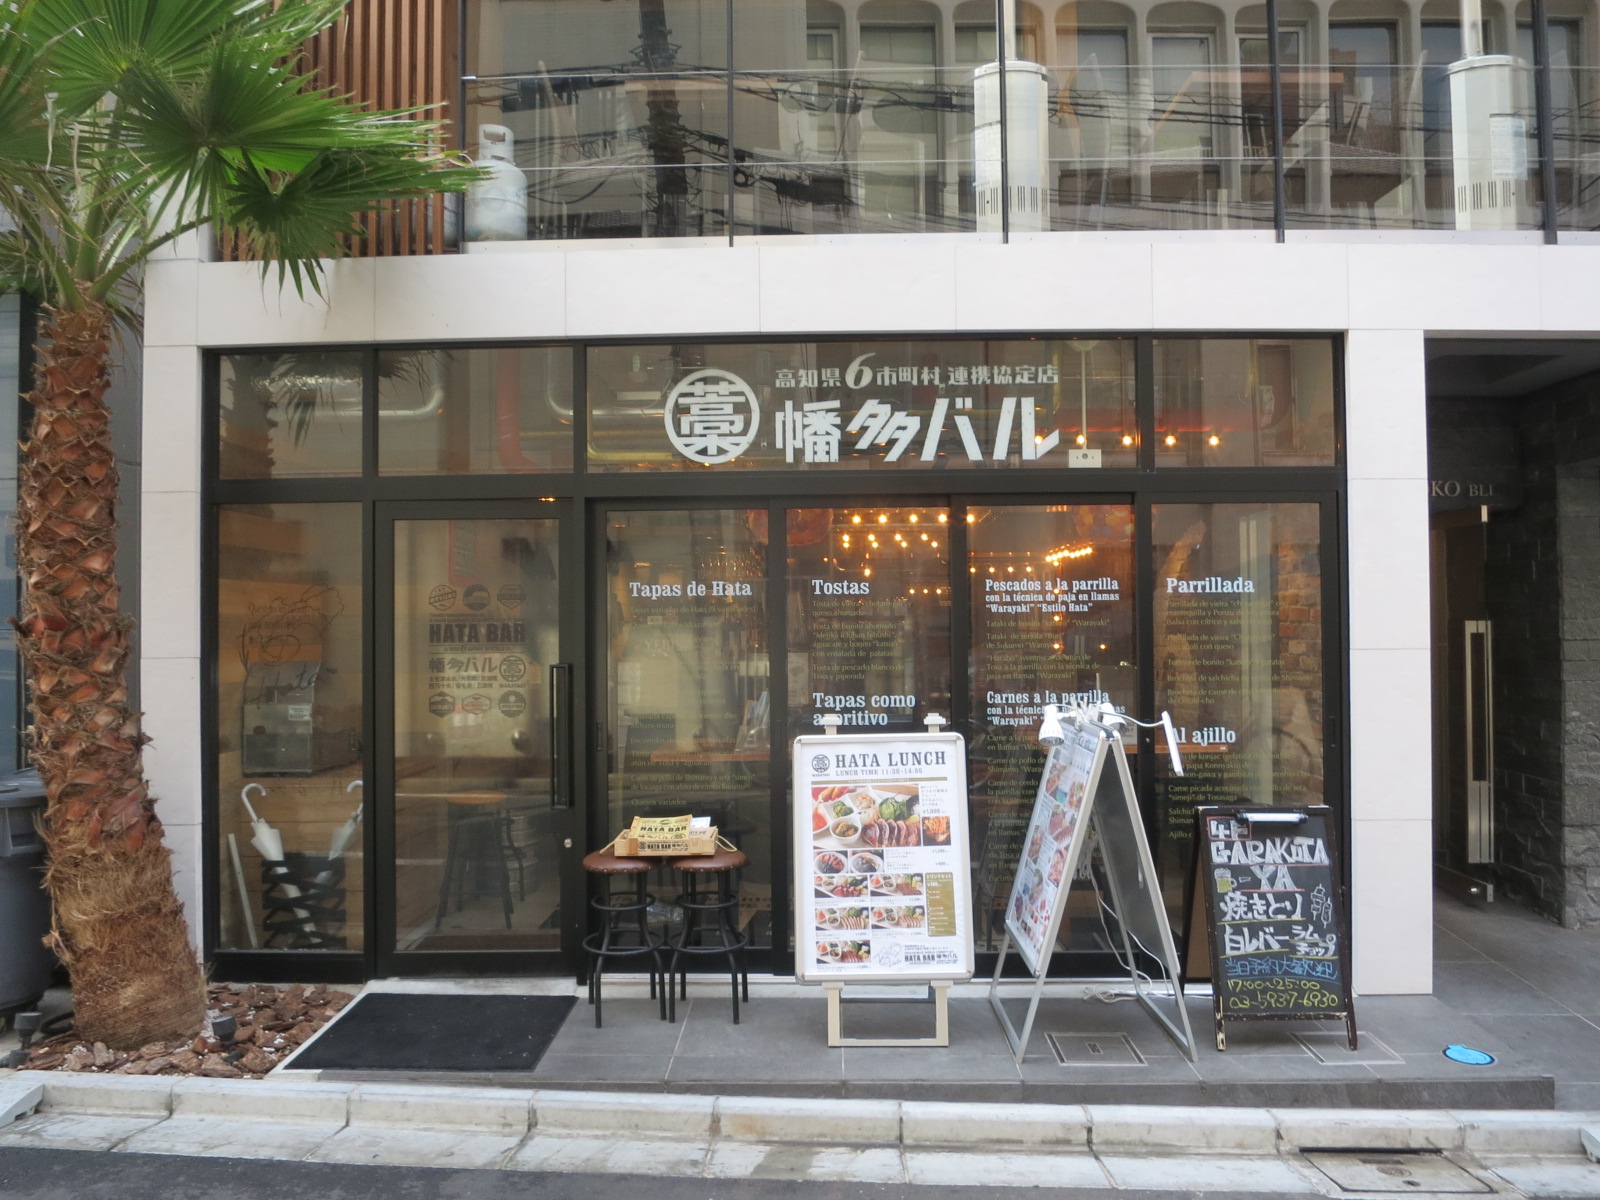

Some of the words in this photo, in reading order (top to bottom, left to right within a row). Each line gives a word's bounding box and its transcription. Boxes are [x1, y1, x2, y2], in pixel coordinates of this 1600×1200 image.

[775, 397, 1059, 463] 幡多バル
[629, 582, 681, 600] Tapas
[687, 581, 706, 596] de
[711, 581, 752, 596] Hata
[812, 579, 869, 595] Tostas
[985, 578, 1041, 591] Pescados
[1045, 581, 1052, 590] a
[1056, 577, 1068, 590] la
[1072, 577, 1119, 592] parrilla
[1166, 577, 1255, 593] Parrillada
[985, 594, 1000, 602] con
[1002, 593, 1011, 602] la
[1013, 592, 1043, 602] técnica
[1045, 593, 1055, 601] de
[1057, 593, 1076, 603] paja
[1090, 592, 1120, 601] llamas
[985, 603, 1035, 614] “Warayaki”
[429, 623, 480, 643] HATA
[486, 623, 525, 643] BAR
[813, 692, 866, 711] Tapas
[871, 695, 916, 708] como
[986, 690, 1029, 704] Carnes
[1033, 693, 1041, 703] a
[1045, 690, 1057, 702] la
[1062, 690, 1110, 705] parrilla
[813, 710, 888, 726] aritivo
[987, 707, 1001, 715] con
[1005, 705, 1013, 714] la
[987, 716, 1037, 727] “Warayaki”
[1192, 727, 1236, 746] ajillo
[835, 753, 881, 769] HATA
[887, 751, 947, 767] LUNCH
[835, 769, 859, 777] LUNCH
[1219, 891, 1303, 921] 焼きとり
[904, 954, 921, 963] HATA
[922, 954, 936, 962] BAR
